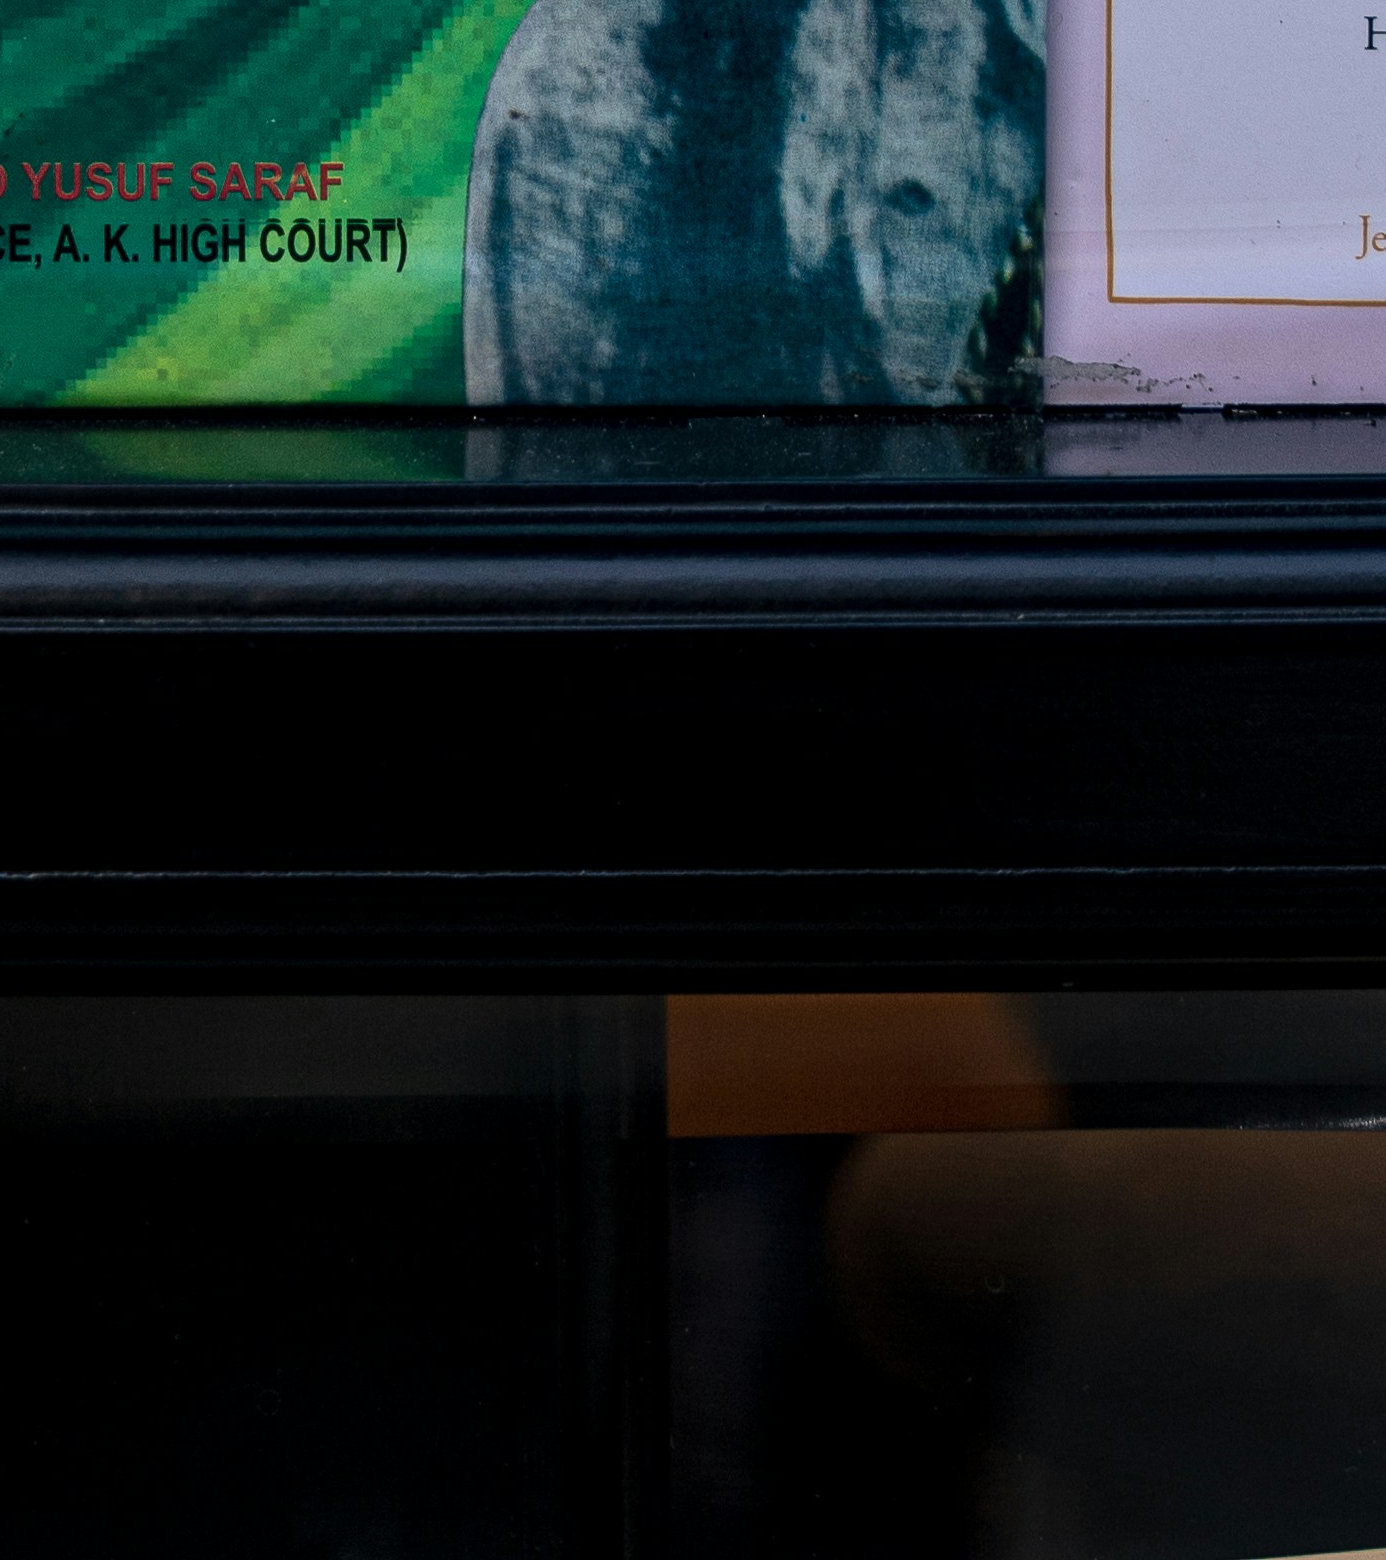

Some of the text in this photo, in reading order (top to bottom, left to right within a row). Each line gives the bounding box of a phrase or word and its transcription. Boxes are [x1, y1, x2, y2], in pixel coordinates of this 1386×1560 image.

[21, 161, 175, 202] YUSUF
[189, 161, 345, 202] SARAF
[53, 222, 90, 264] A.
[104, 222, 140, 264] K.
[153, 220, 247, 264] HIGH
[259, 218, 408, 274] COURT)
